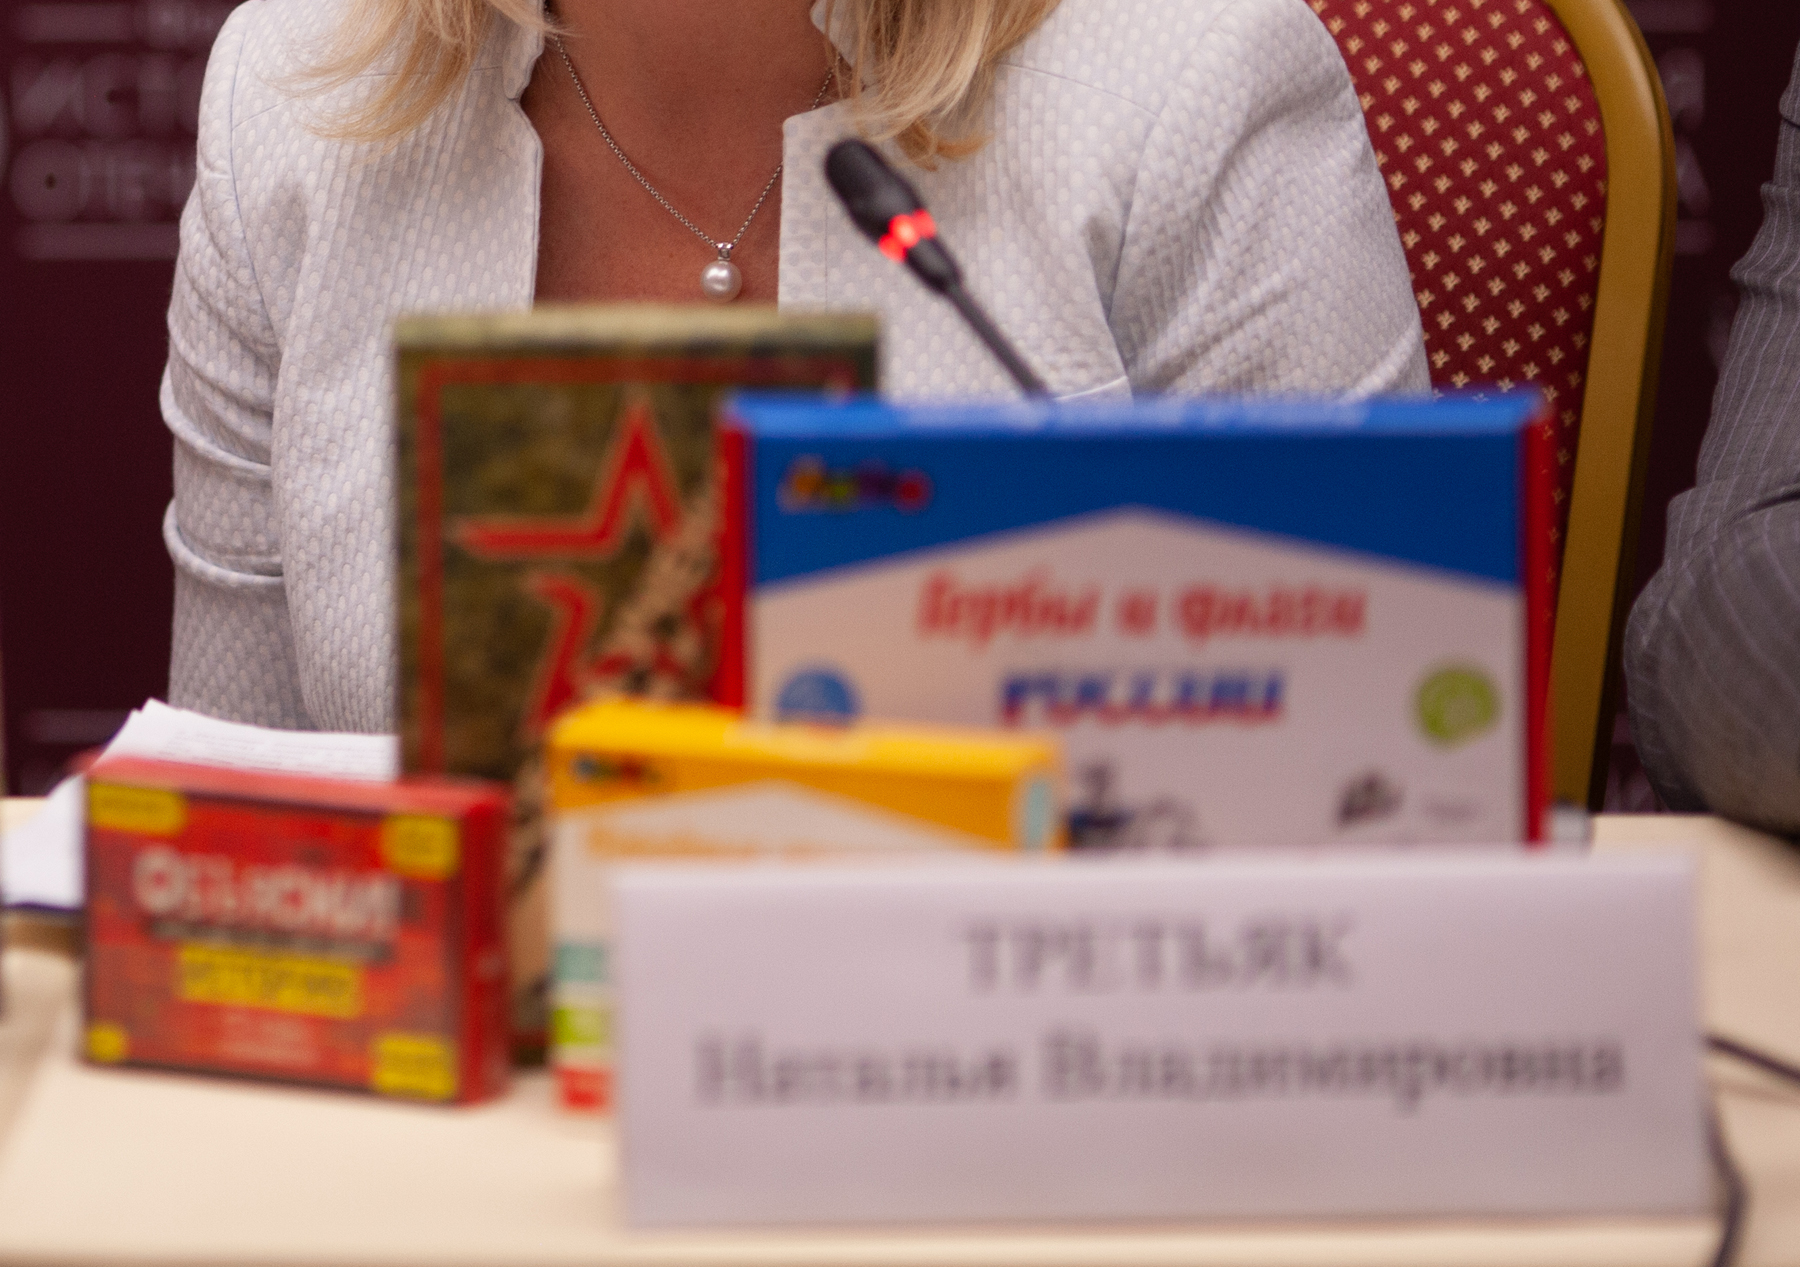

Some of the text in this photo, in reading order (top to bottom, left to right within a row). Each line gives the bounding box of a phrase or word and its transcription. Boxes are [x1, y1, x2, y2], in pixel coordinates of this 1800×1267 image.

[962, 912, 1356, 991] ТРЕТЬЯК
[693, 1028, 1626, 1116] Наталья Владимировна
